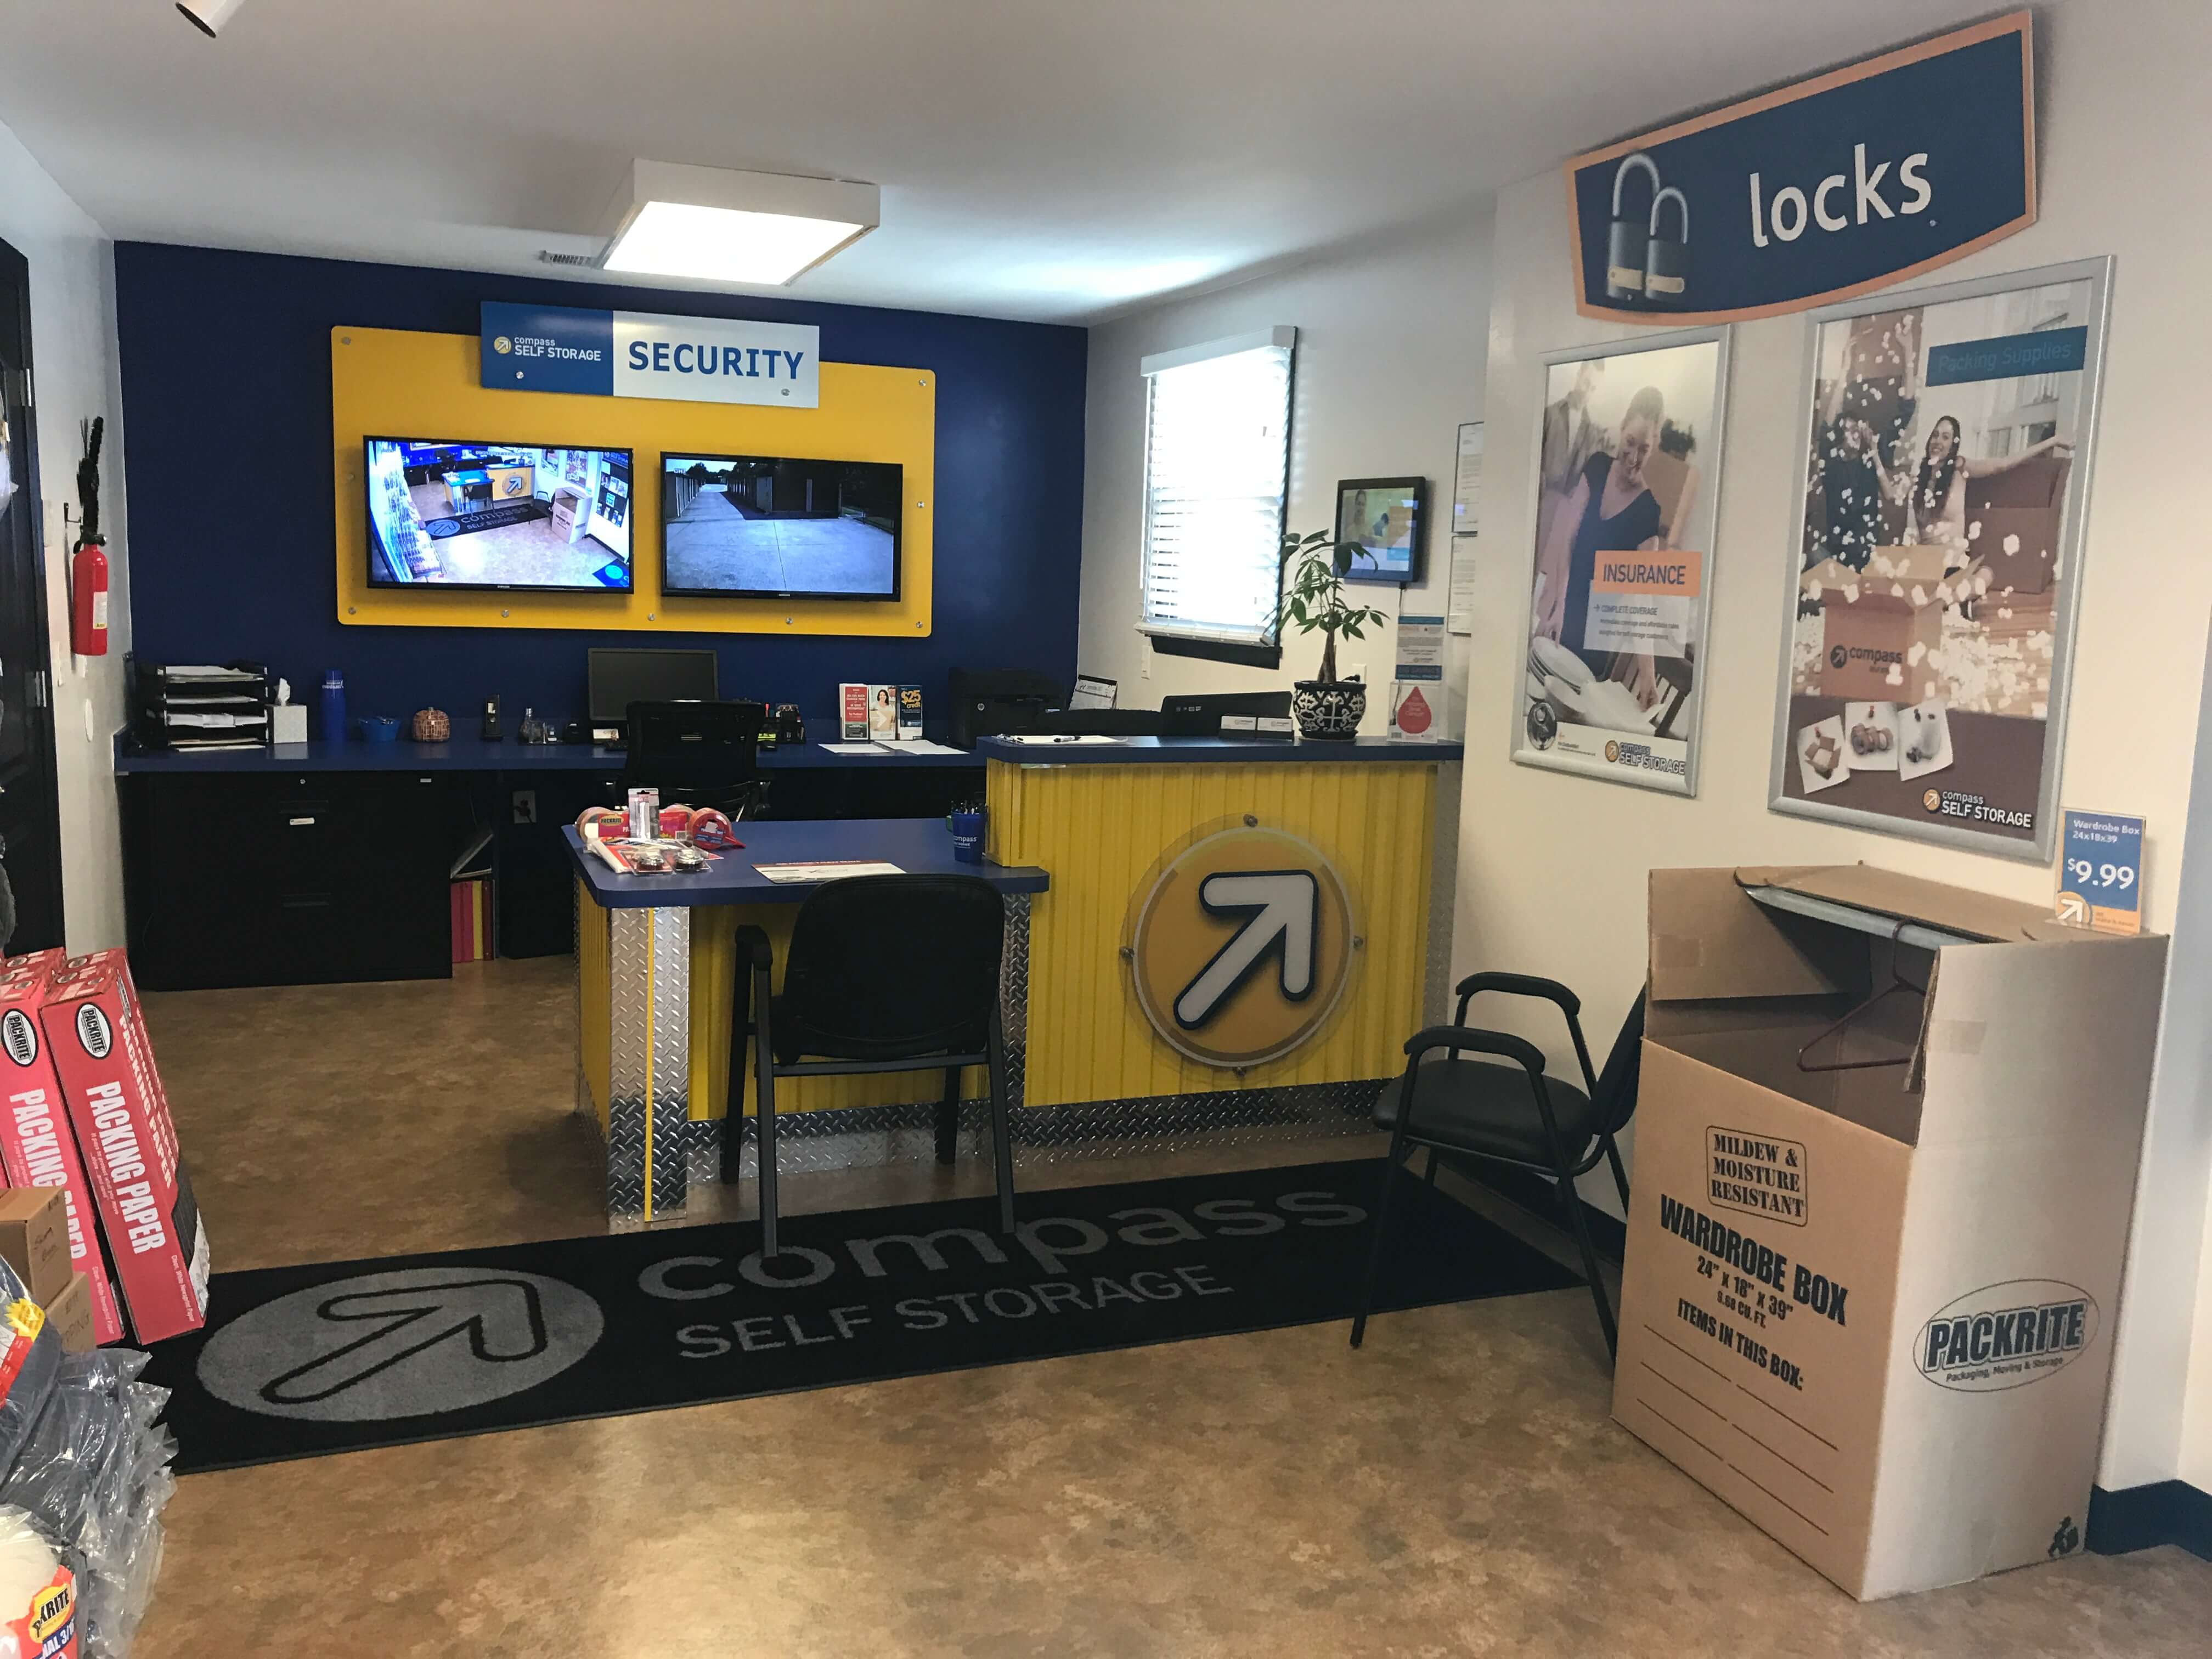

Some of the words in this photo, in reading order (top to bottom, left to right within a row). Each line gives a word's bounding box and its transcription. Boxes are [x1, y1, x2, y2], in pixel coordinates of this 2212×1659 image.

[1750, 143, 1932, 248] locks
[514, 336, 556, 347] compass
[515, 345, 545, 358] SELF
[548, 347, 601, 362] STORAGE
[1938, 351, 1997, 373] Packing
[2002, 342, 2072, 367] Supplies
[628, 341, 804, 380] SECURITY
[461, 507, 528, 523] compass
[1603, 565, 1686, 585] INSURANCE
[1601, 605, 1628, 613] COMPLETE
[1629, 607, 1658, 616] COVERAGE
[1849, 647, 1902, 664] compass
[901, 690, 921, 705] $25
[1619, 742, 1651, 755] compass
[1619, 752, 1641, 768] SELF
[1642, 755, 1686, 775] STORAGE
[1942, 791, 1984, 804] compass
[1942, 801, 1972, 816] SELF
[1974, 805, 2032, 827] STORAGE
[2073, 820, 2119, 833] Wardrobe
[2121, 825, 2140, 834] Box
[2073, 830, 2118, 843] 24x18x39
[2068, 857, 2134, 889] $9.99
[8, 1014, 32, 1060] PACKRITE
[82, 1007, 107, 1053] PACKRITE
[120, 1014, 150, 1115] PACKING
[149, 1116, 172, 1189] PAPER
[9, 1088, 68, 1187] PACKING
[1713, 1134, 1780, 1164] MILDEW
[1785, 1148, 1798, 1167] &
[86, 1081, 145, 1183] PACKING
[116, 1181, 166, 1255] PAPER
[1713, 1156, 1800, 1193] MOISTURE
[1711, 1179, 1804, 1217] RESISTANT
[637, 1191, 1369, 1299] compass
[1660, 1193, 1788, 1293] WARDROBE
[1793, 1263, 1850, 1325] BOX
[1697, 1255, 1720, 1278] 24"
[1768, 1295, 1793, 1321] 39"
[186, 1308, 195, 1322] Paper
[676, 1304, 873, 1358] SELF
[894, 1265, 1234, 1329] STORAGE
[1677, 1297, 1717, 1337] ITEMS
[1718, 1322, 1734, 1348] IN
[1736, 1331, 1768, 1368] THIS
[1769, 1352, 1804, 1391] BOX:
[1925, 1299, 2087, 1371] PACKRITE
[1993, 1364, 2023, 1374] Moving
[2024, 1361, 2031, 1370] &
[2033, 1357, 2063, 1368] Storage
